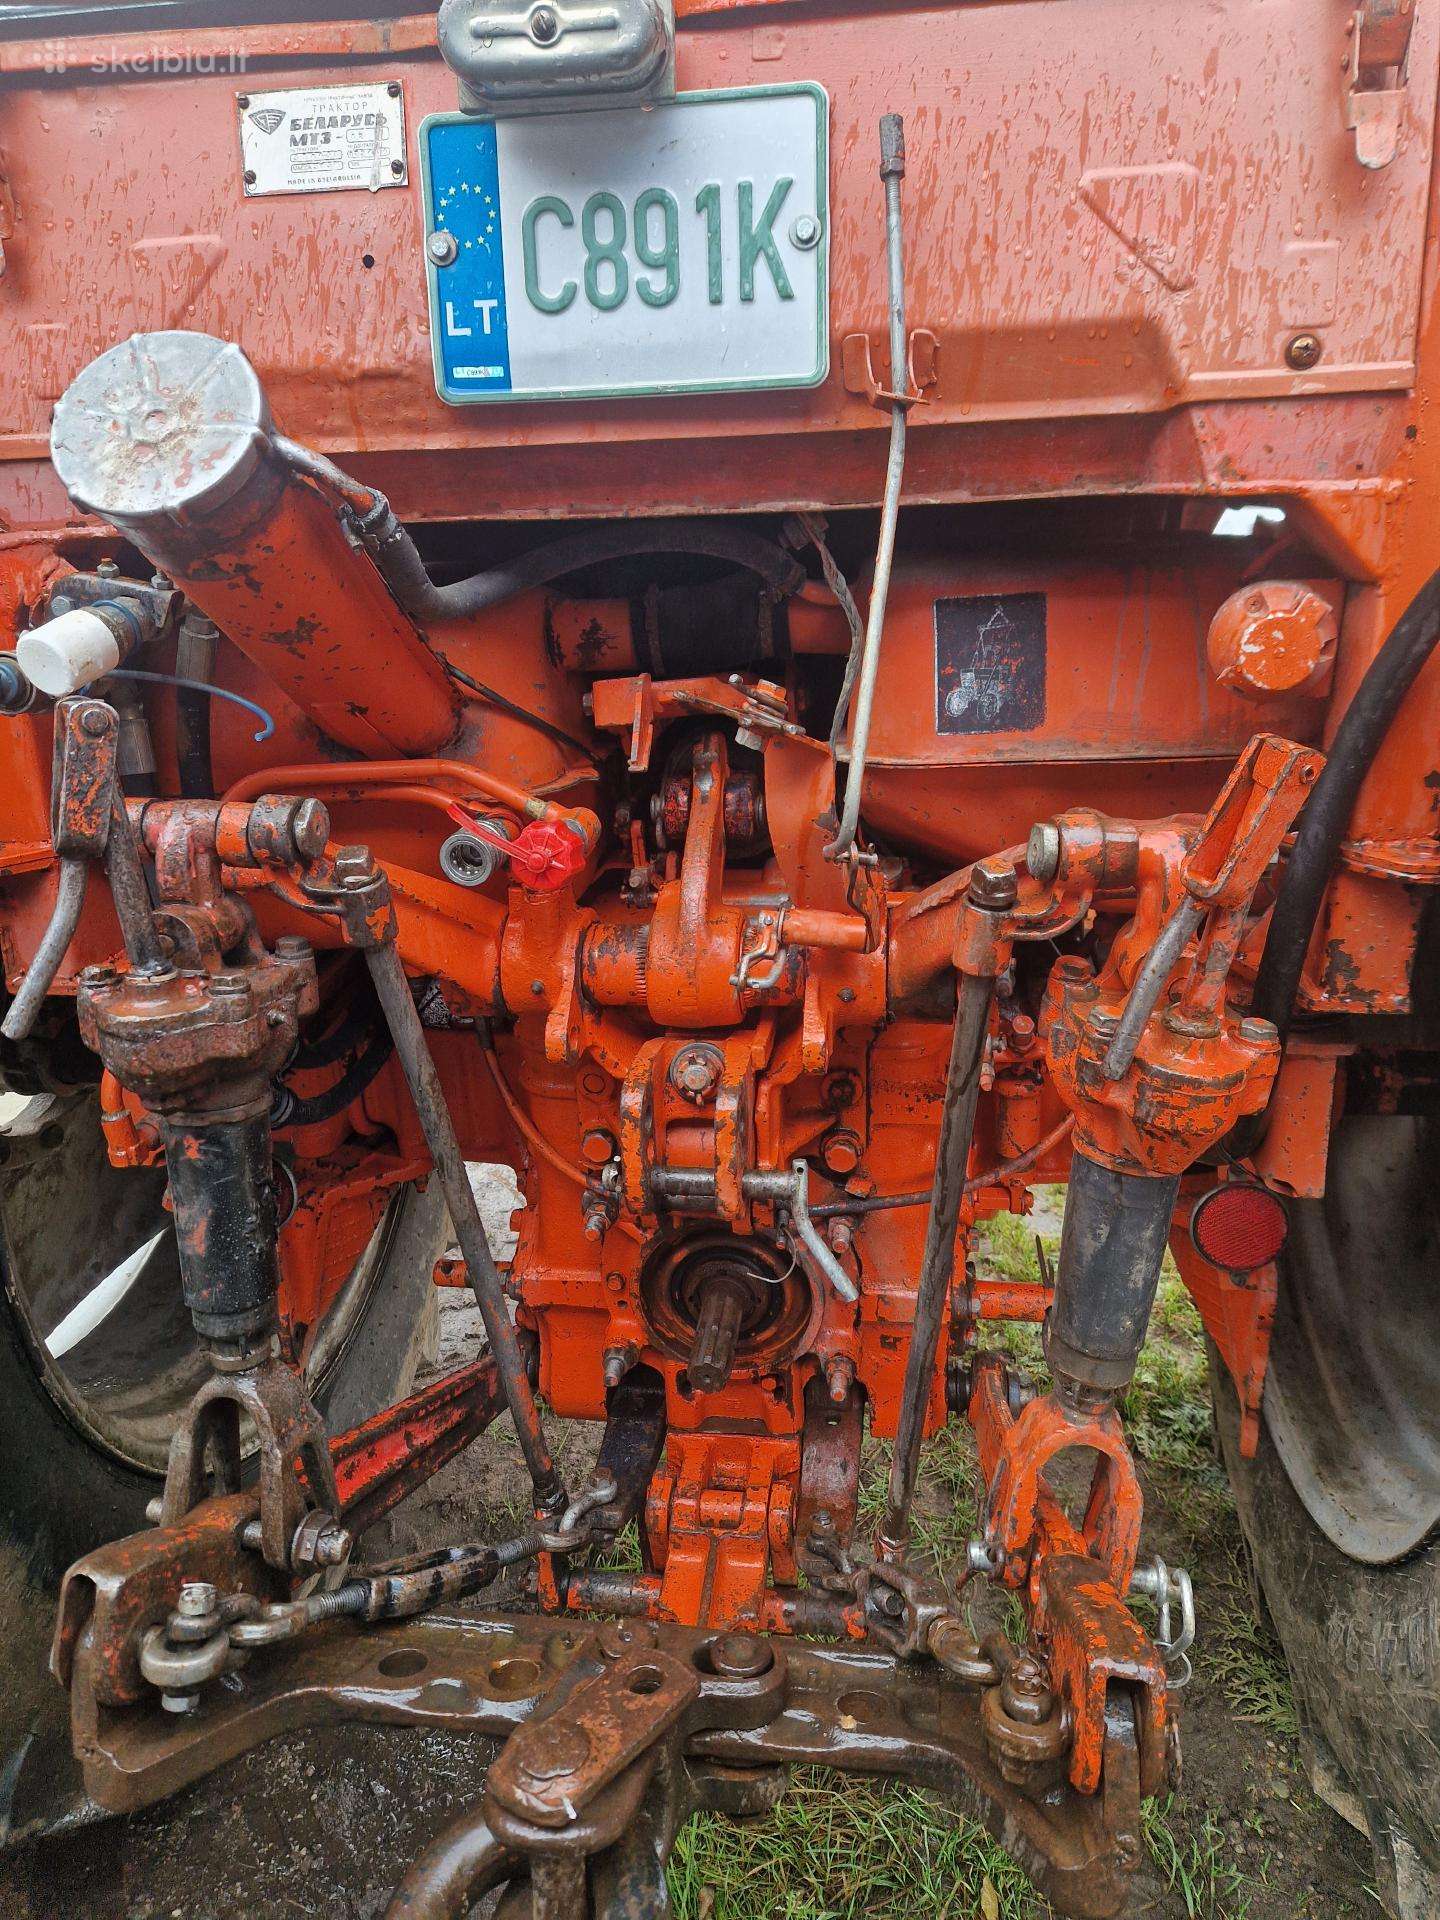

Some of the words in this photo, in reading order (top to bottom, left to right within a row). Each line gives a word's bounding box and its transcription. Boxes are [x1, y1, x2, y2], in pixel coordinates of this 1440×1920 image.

[290, 112, 387, 131] БЕЛАРУСЬ
[522, 176, 795, 314] C891K
[445, 299, 498, 336] LT
